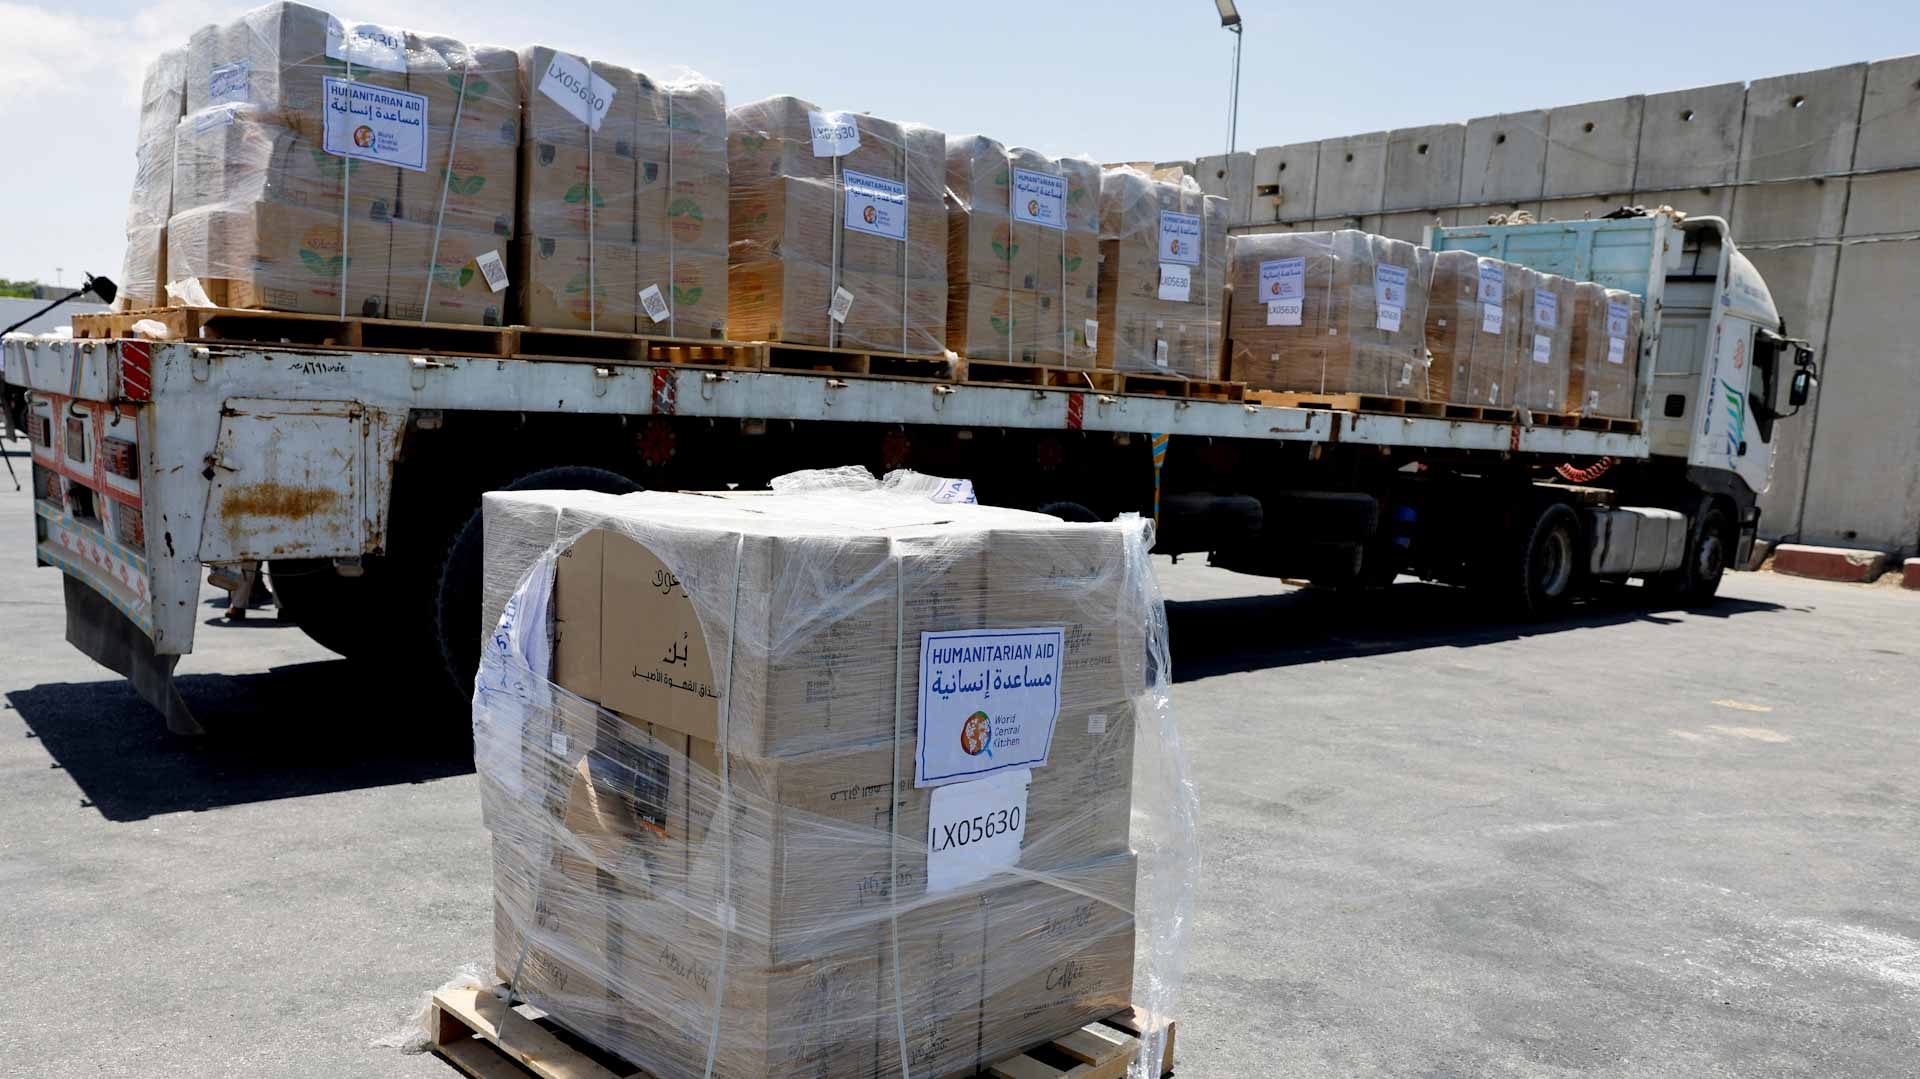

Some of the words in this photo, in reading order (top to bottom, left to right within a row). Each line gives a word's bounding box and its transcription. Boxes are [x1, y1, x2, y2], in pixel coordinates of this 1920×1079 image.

[331, 85, 403, 107] HUMANITARIAN
[405, 101, 420, 111] AID
[548, 63, 604, 111] LX05630
[331, 97, 373, 121] إنسانية
[376, 106, 420, 126] مساعدة
[1269, 305, 1299, 314] LX05630
[932, 644, 1033, 665] HUMANITARIAN
[1035, 643, 1055, 660] AID
[931, 668, 991, 700] إنسانية
[993, 665, 1052, 690] مساعدة
[994, 724, 1022, 736] Central
[995, 714, 1017, 725] World
[993, 736, 1021, 749] Kitchen
[931, 806, 1021, 852] LX05630
